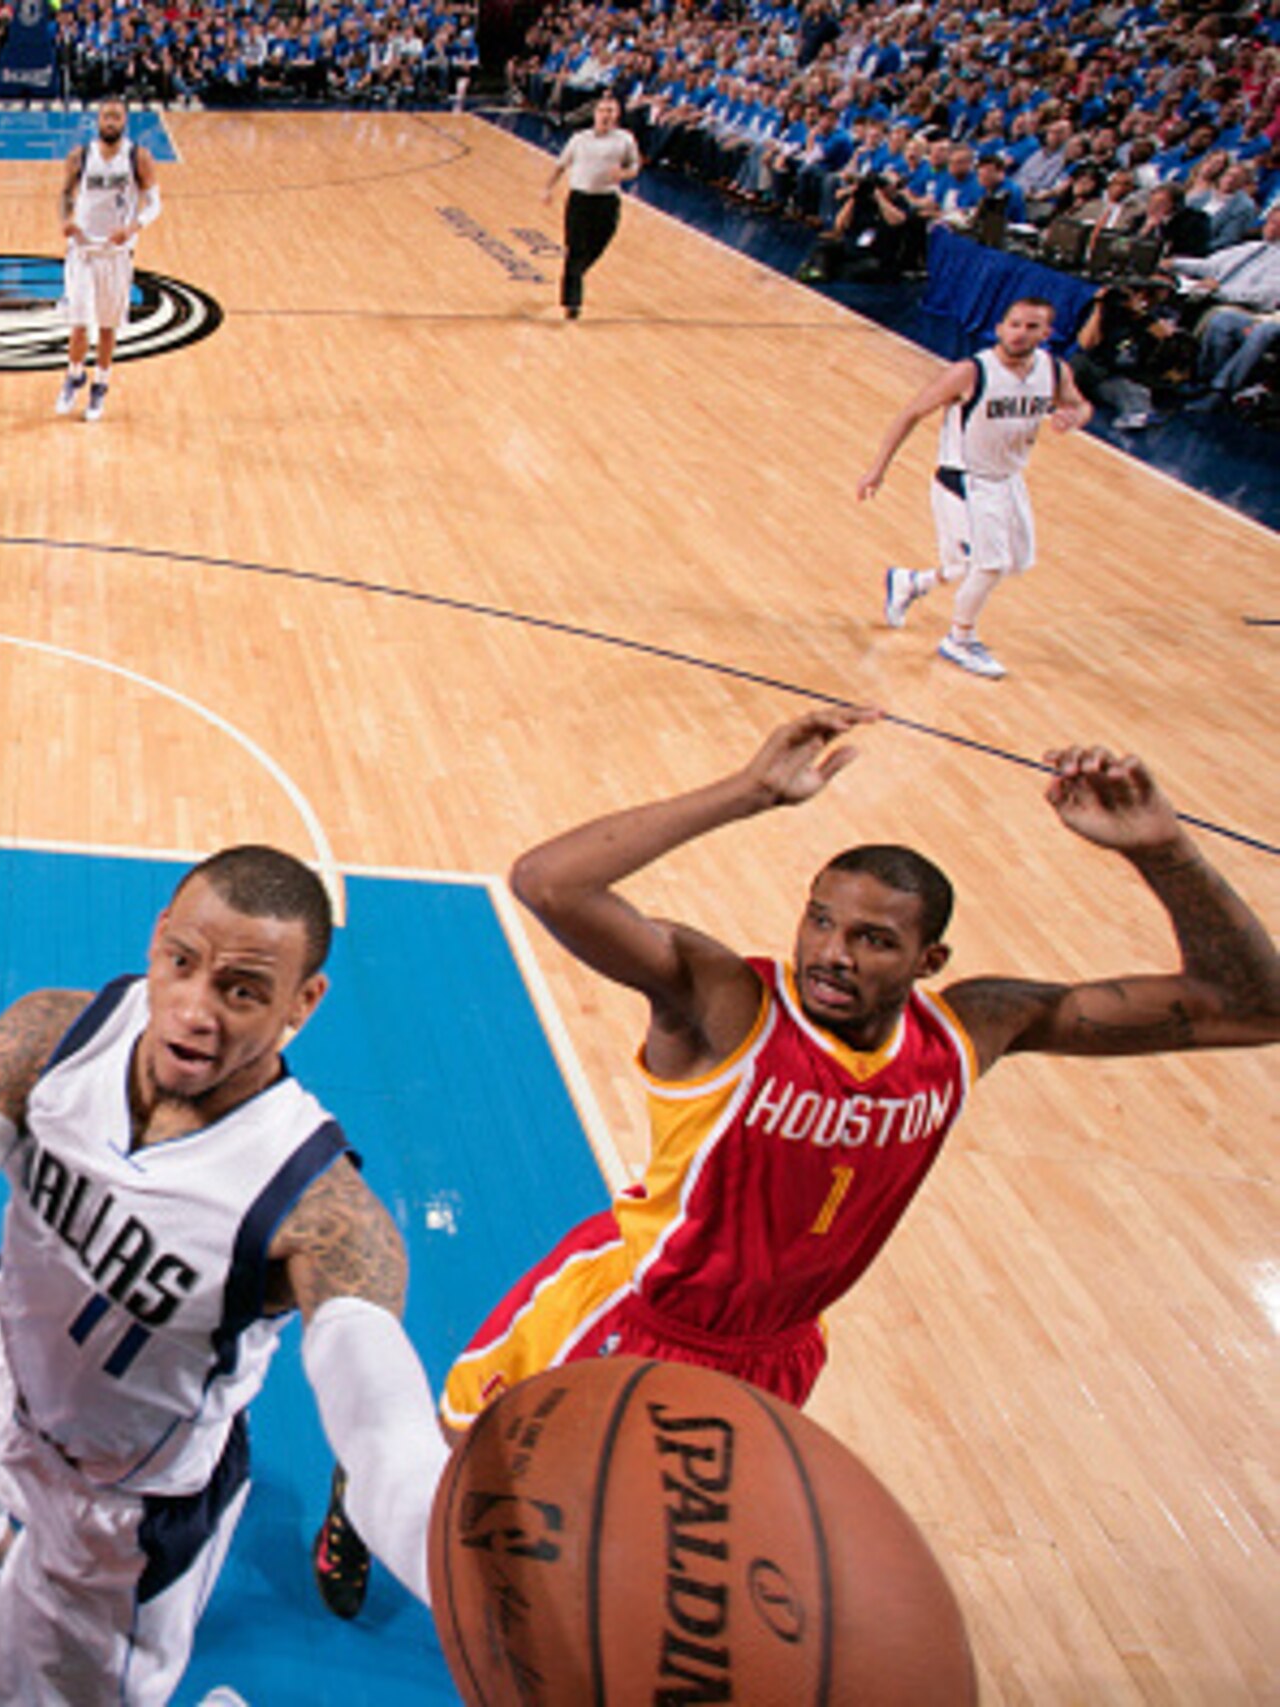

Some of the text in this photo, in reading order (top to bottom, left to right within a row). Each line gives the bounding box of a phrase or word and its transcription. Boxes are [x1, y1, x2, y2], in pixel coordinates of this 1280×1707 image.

[987, 396, 1056, 419] DALLAS
[745, 1077, 954, 1147] HOUSTON
[810, 1166, 855, 1235] 1
[22, 1148, 198, 1327] ALLAS
[68, 1293, 152, 1379] 11
